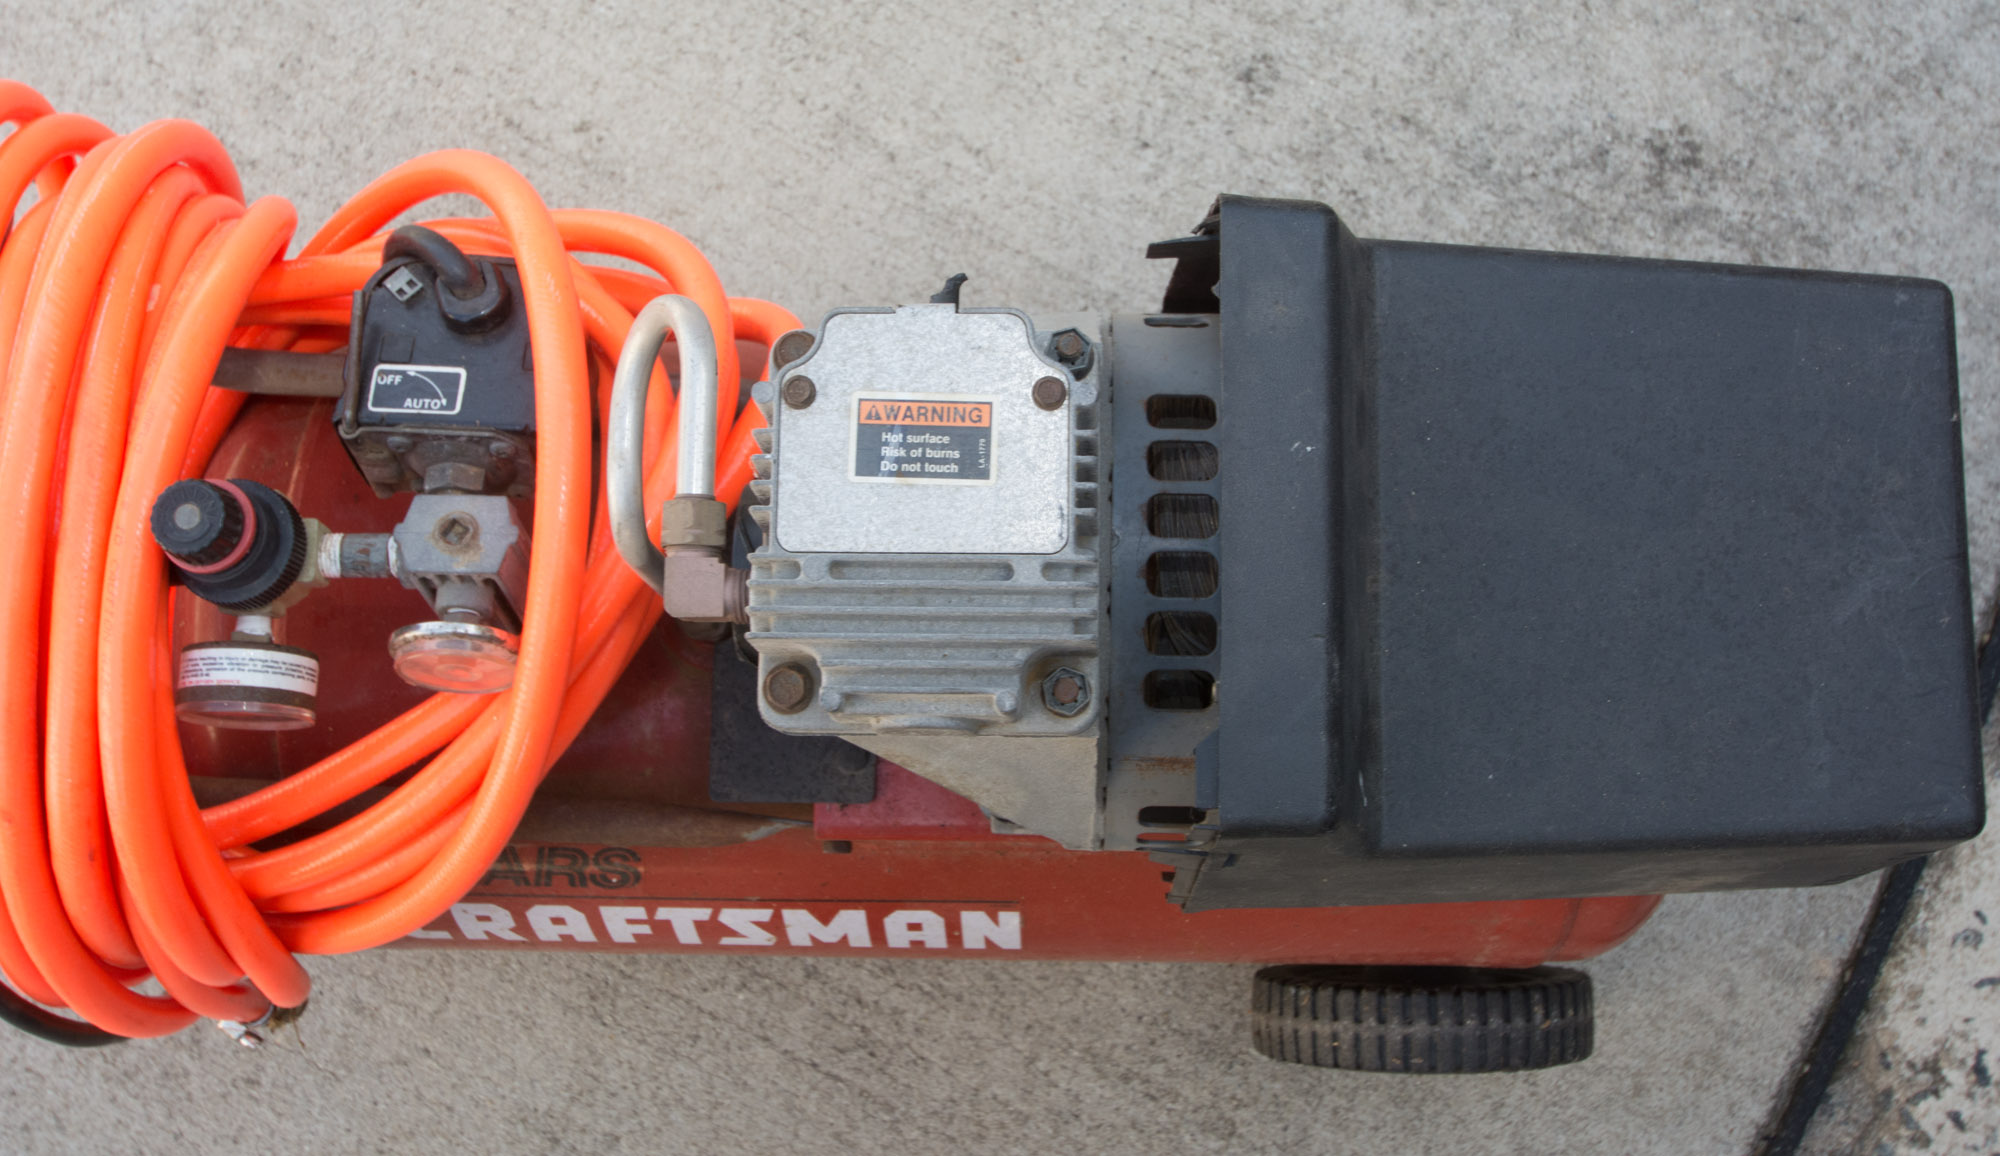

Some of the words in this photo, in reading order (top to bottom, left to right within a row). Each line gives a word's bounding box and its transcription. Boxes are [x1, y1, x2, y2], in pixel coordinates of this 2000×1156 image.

[377, 374, 403, 386] OFF
[403, 398, 441, 410] AUTO
[883, 404, 983, 424] WARNING
[881, 432, 904, 443] Hot
[906, 433, 951, 444] surface
[880, 446, 907, 457] Risk
[909, 447, 923, 458] of
[925, 447, 961, 459] burns
[880, 460, 898, 471] Do
[901, 462, 922, 472] not
[924, 463, 959, 473] touch
